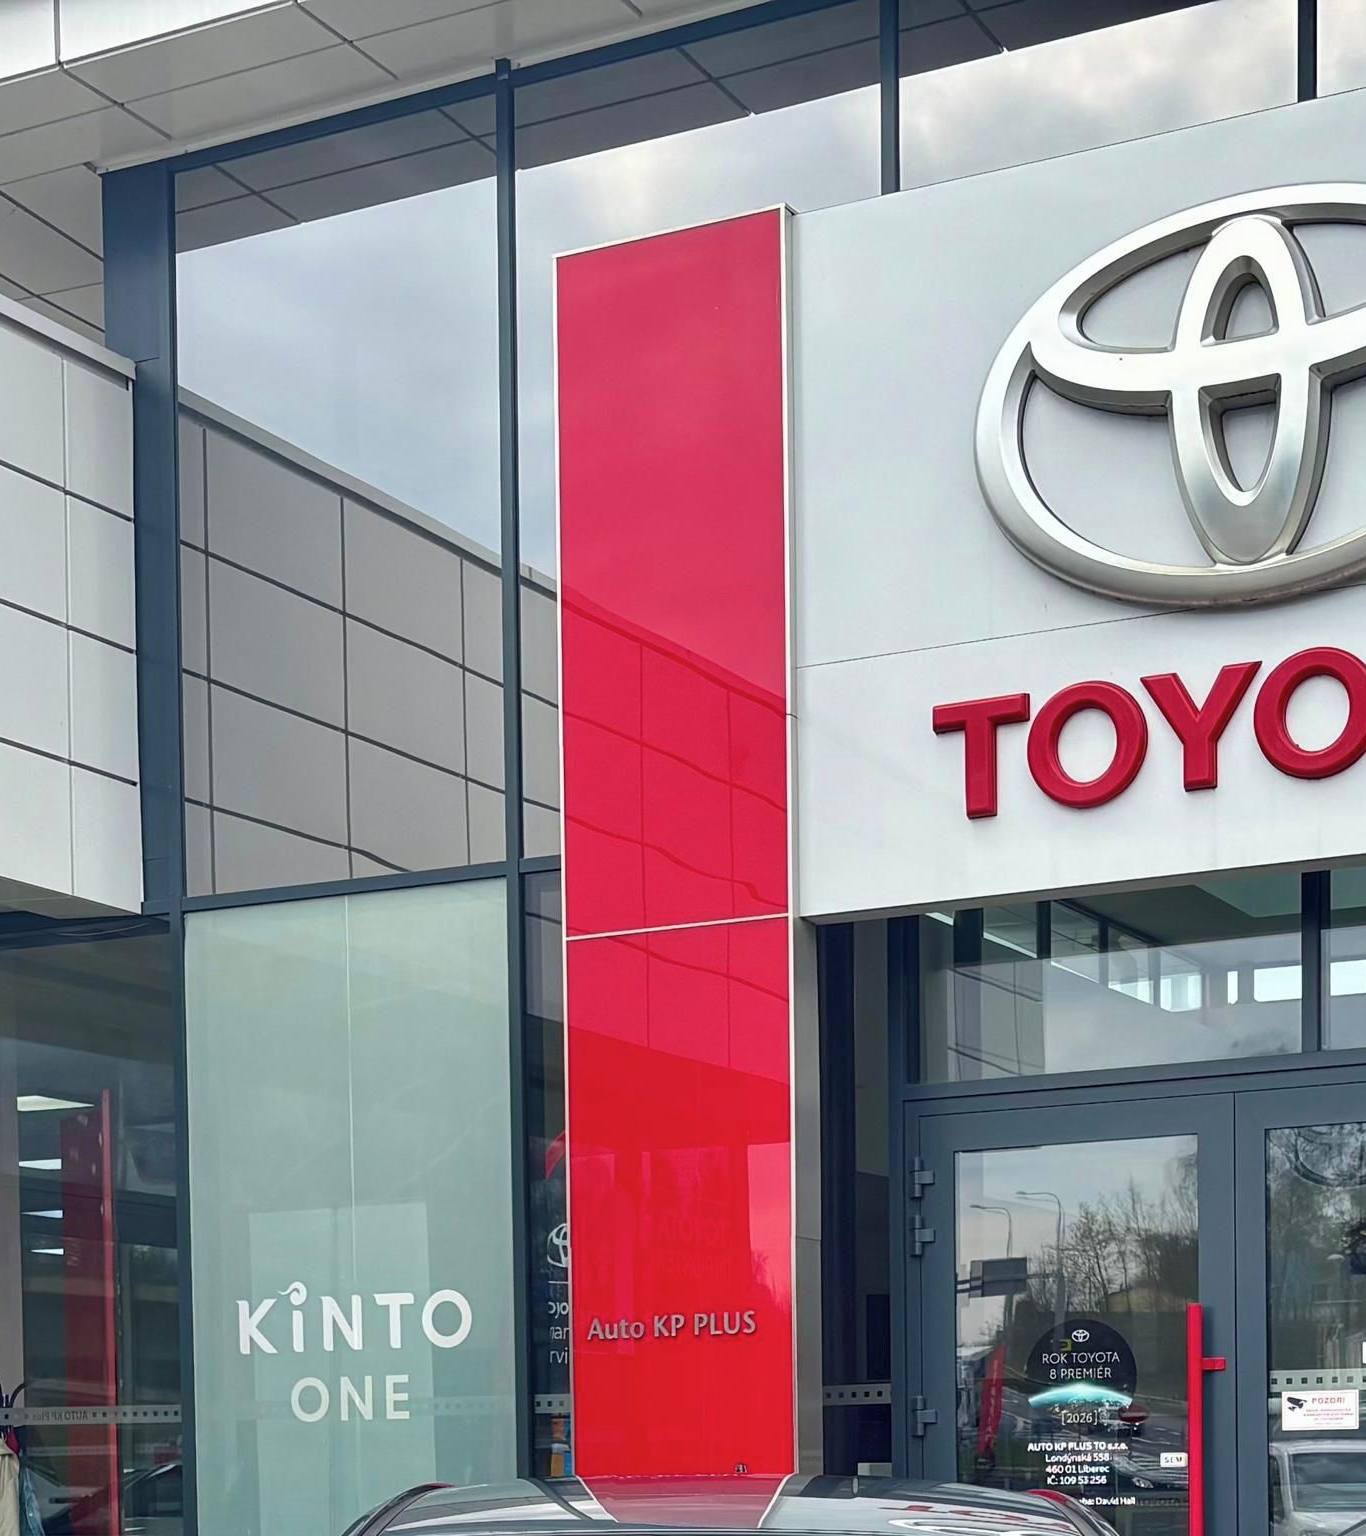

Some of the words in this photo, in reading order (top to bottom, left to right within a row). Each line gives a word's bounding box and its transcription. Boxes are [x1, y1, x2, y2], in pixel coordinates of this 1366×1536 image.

[587, 1317, 645, 1341] Auto
[653, 1314, 686, 1338] KP
[693, 1310, 757, 1337] PLUS
[1042, 1352, 1067, 1365] ROK
[1072, 1351, 1120, 1364] TOYOTA
[1049, 1368, 1057, 1380] 8
[1060, 1365, 1112, 1379] PREMIÉR
[290, 1373, 411, 1423] ONE
[1027, 1442, 1053, 1452] AUTO
[1054, 1442, 1067, 1451] KP
[1068, 1442, 1092, 1451] PLUS
[1093, 1441, 1106, 1450] TO
[1045, 1452, 1092, 1464] Londýnská
[1045, 1465, 1065, 1474] 460
[1065, 1465, 1076, 1474] 01
[1078, 1465, 1110, 1473] Liberec
[1059, 1476, 1077, 1485] 109
[1078, 1476, 1089, 1485] 53
[1089, 1476, 1107, 1484] 256
[1095, 1497, 1119, 1506] David
